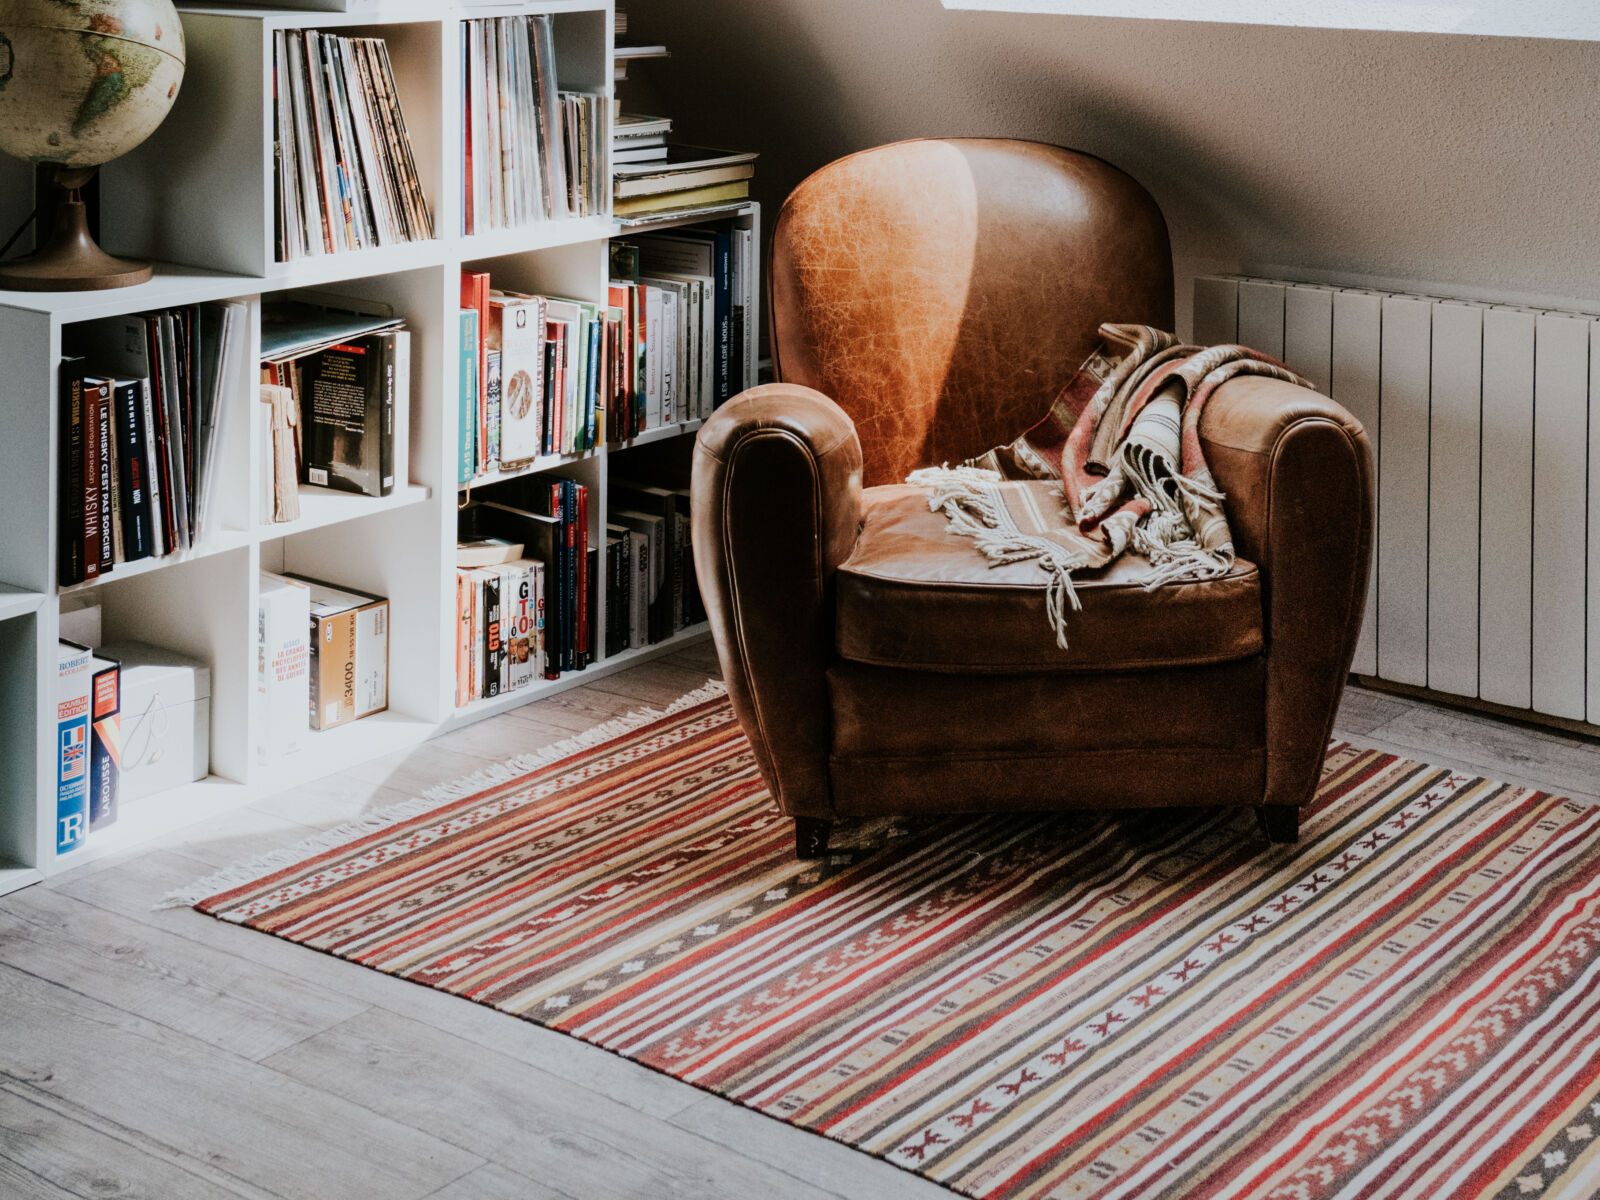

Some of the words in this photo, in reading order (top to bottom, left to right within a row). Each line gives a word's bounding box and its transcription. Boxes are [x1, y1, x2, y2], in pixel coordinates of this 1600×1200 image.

[72, 380, 80, 426] WHISKIES
[100, 406, 107, 419] LE
[100, 421, 108, 462] WHISKY
[101, 463, 109, 491] C'EST
[133, 489, 141, 504] NON
[85, 487, 98, 539] WHISKY
[102, 514, 110, 559] SORCIER
[519, 581, 528, 633] GTO
[489, 622, 499, 651] GTO
[59, 656, 89, 671] ROBERT
[59, 697, 88, 710] NOUVELLE
[490, 682, 497, 695] 5
[102, 755, 110, 818] LAROUSSE
[60, 812, 82, 846] R
